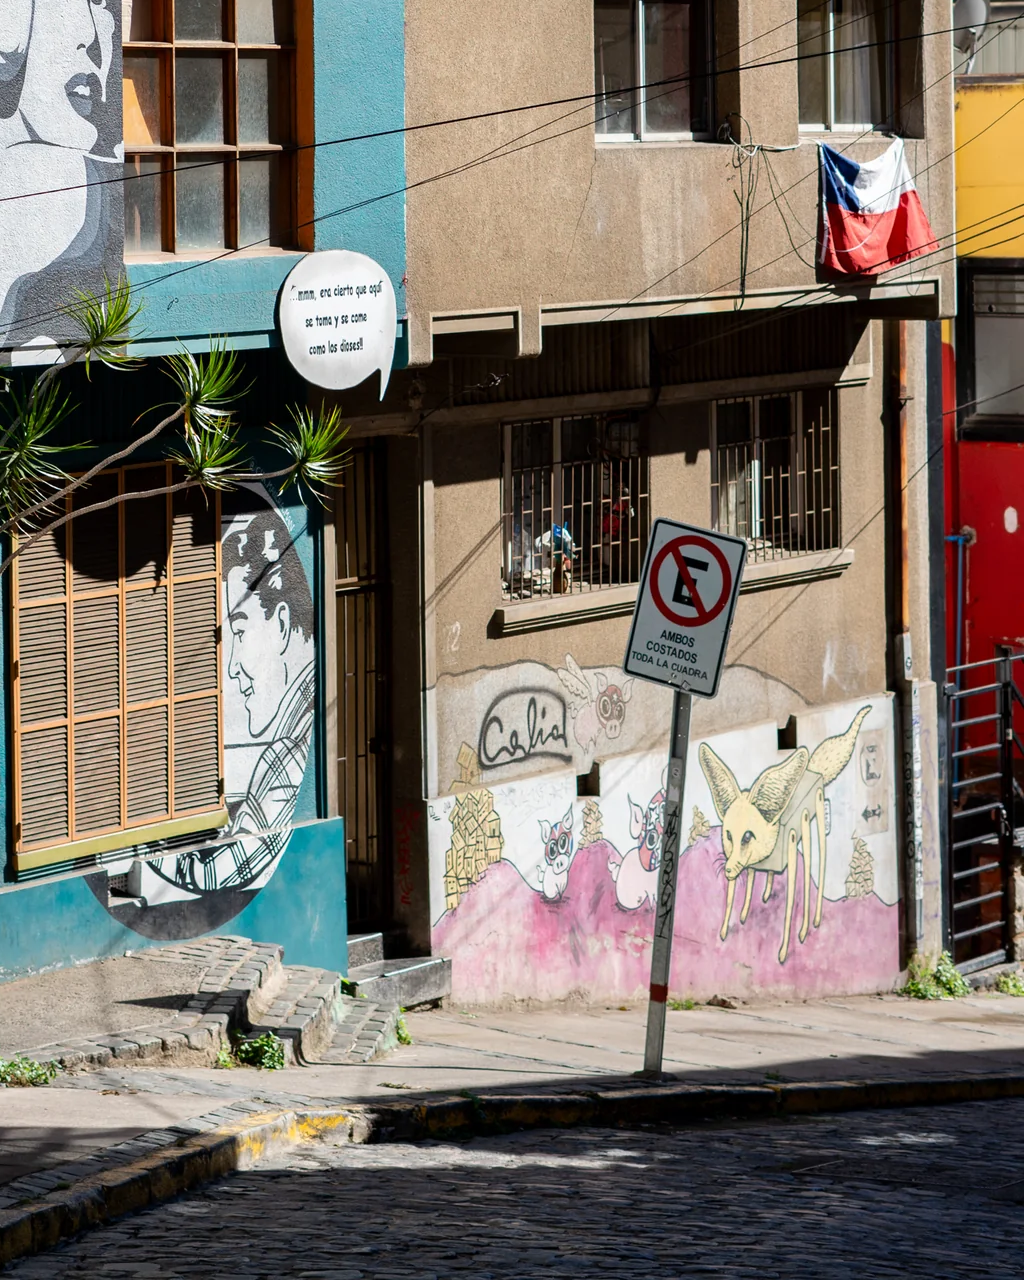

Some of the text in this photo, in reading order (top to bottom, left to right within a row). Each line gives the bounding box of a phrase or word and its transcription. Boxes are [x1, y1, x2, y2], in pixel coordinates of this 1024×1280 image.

[319, 287, 332, 298] era
[333, 284, 354, 297] cierto
[355, 285, 367, 299] que
[305, 313, 367, 329] se toma y se come
[309, 344, 326, 355] como
[328, 339, 338, 353] los
[660, 629, 695, 648] AMBOS
[646, 640, 698, 664] COSTADOS
[632, 650, 708, 680] TODA LA CUADRA
